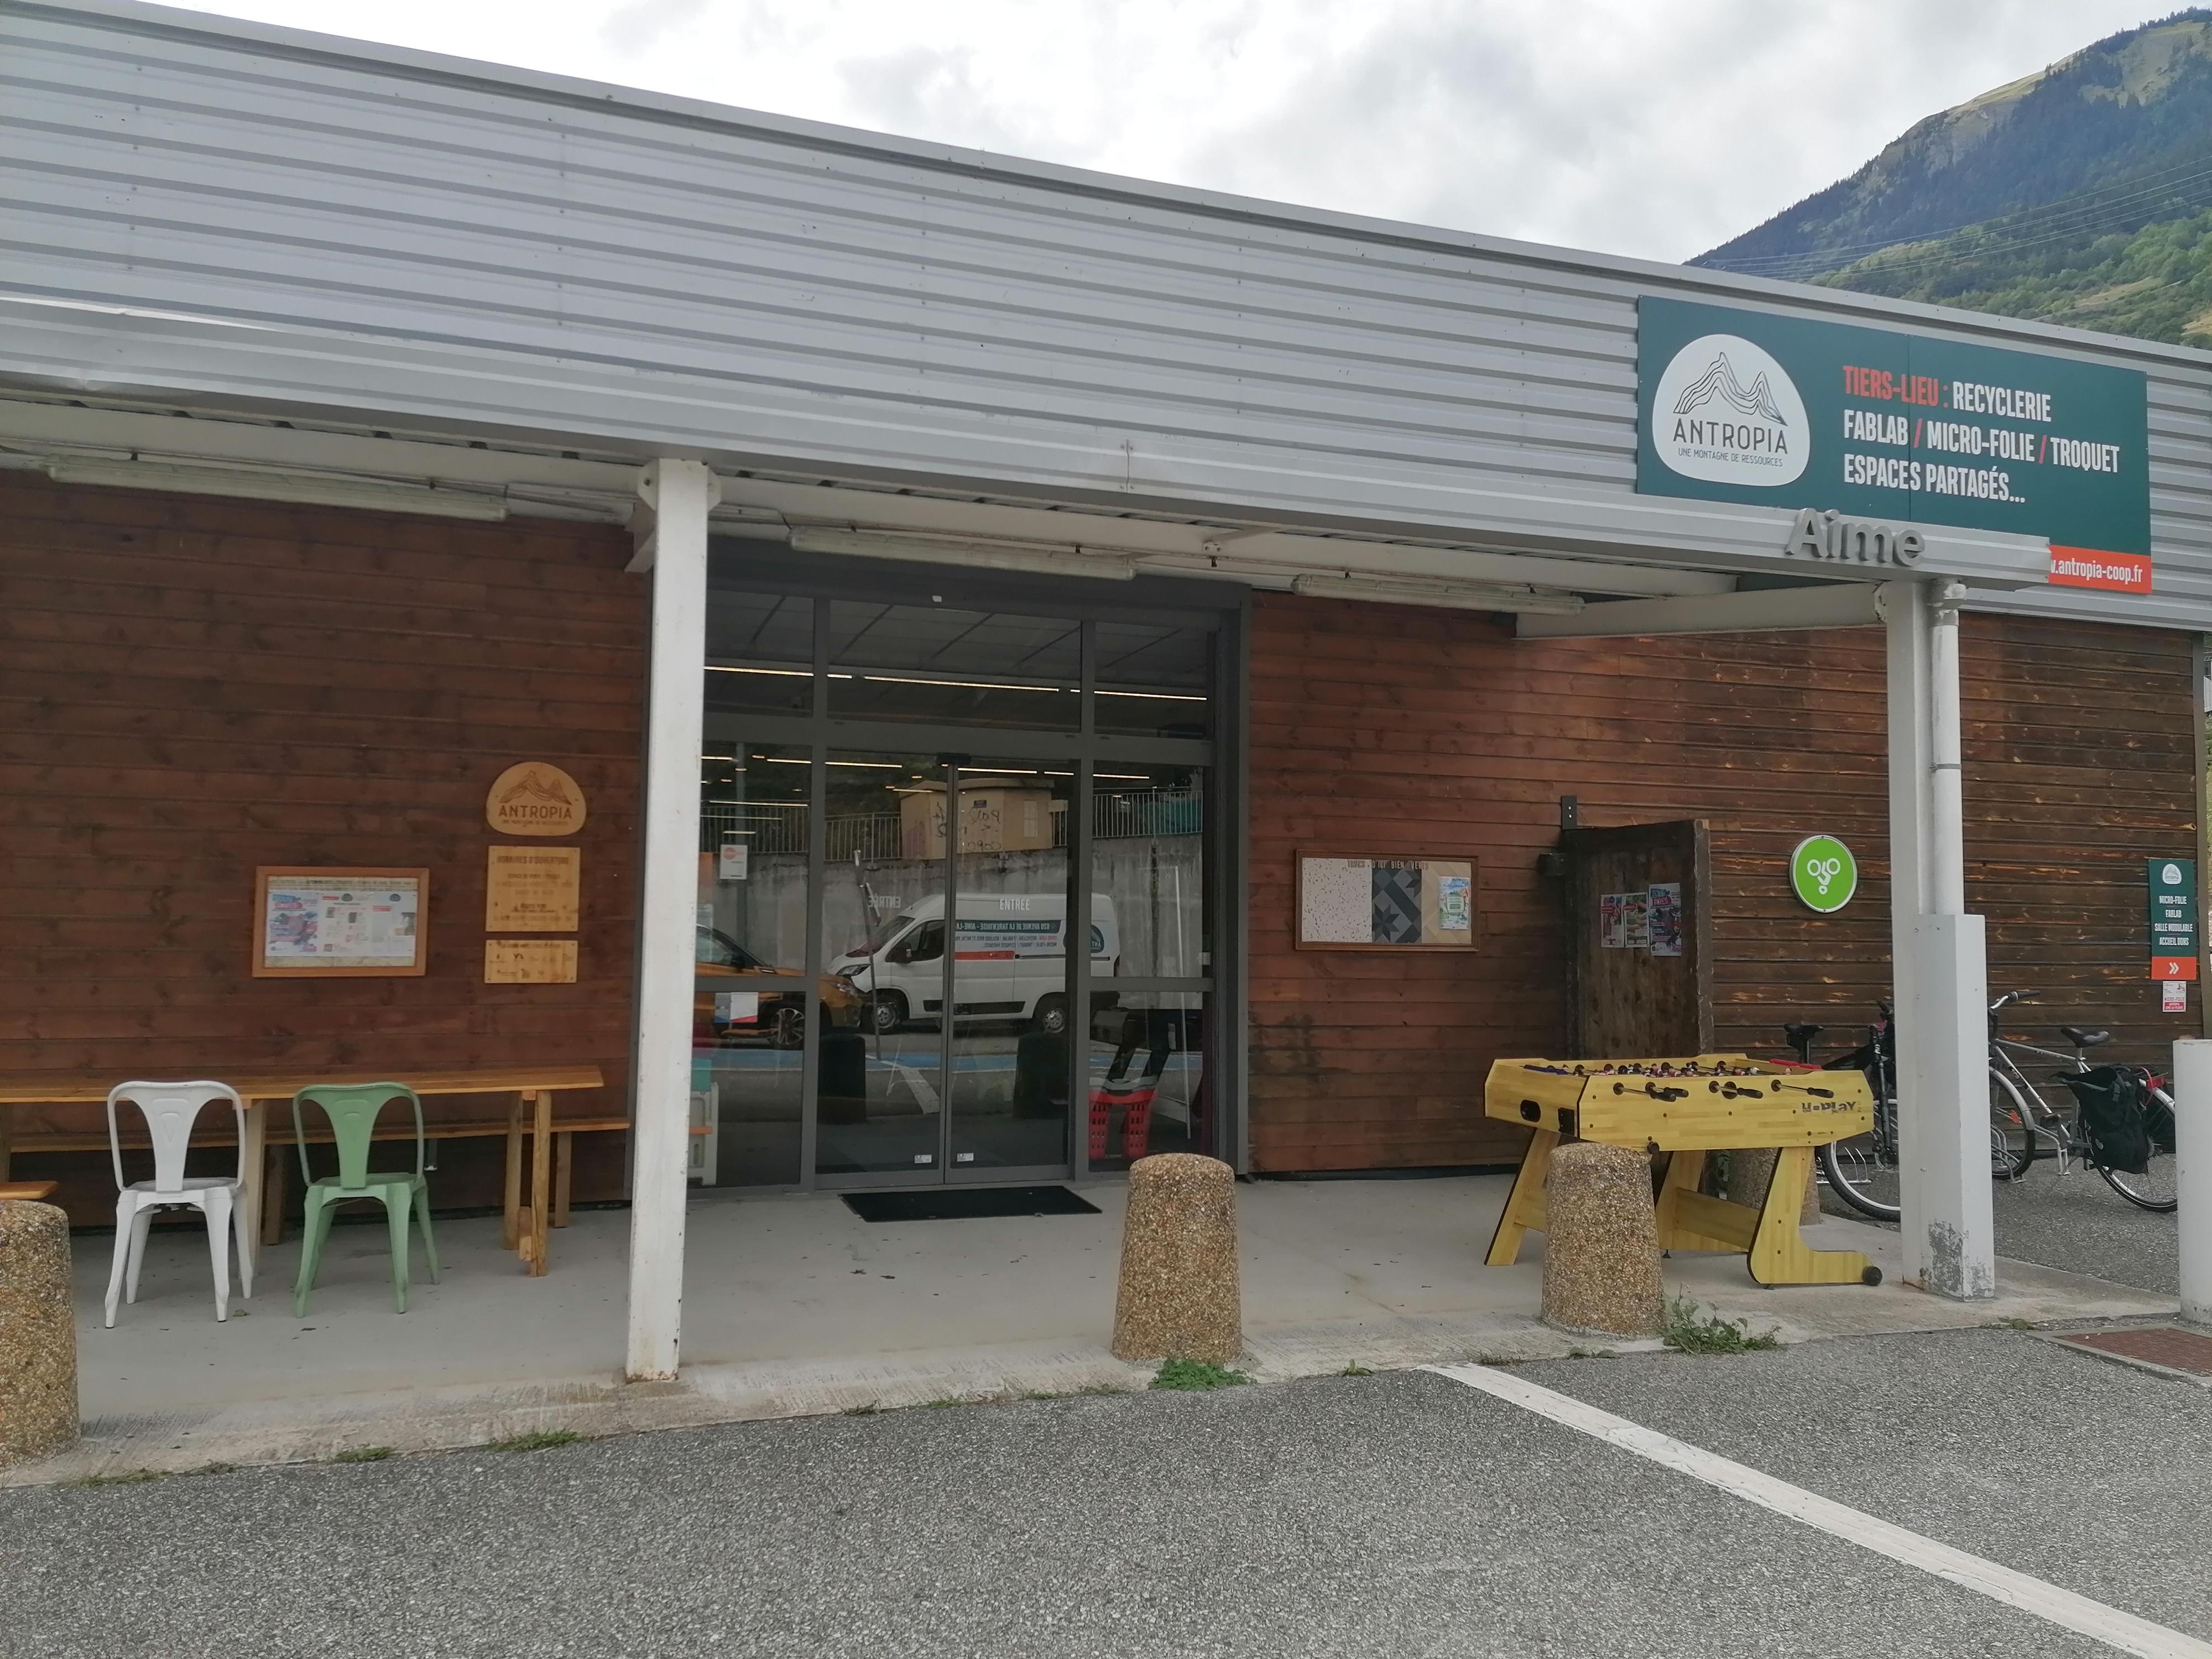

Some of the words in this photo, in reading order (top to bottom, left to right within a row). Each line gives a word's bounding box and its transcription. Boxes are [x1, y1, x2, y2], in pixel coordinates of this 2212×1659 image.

[1843, 366, 1939, 406] TIERS-LIEU
[1953, 382, 2051, 422] RECYCLERIE
[1673, 418, 1788, 454] ANTROPIA
[1844, 410, 1908, 446] FABLAB
[1927, 421, 2035, 462] MICRO-FOLIE
[2050, 437, 2120, 473] TROQUET
[1678, 447, 1691, 457] UNE
[1693, 449, 1729, 461] MONTAGNE
[1731, 453, 1739, 462] DE
[1741, 454, 1783, 467] RESSOURCES
[1844, 453, 1921, 491] ESPACES
[1926, 464, 2026, 503] PARTAGÉS...
[1785, 508, 1925, 567] Aime
[499, 805, 572, 820] ANTROPIA
[2159, 895, 2187, 905] MICRO-FOLIE
[2166, 910, 2182, 918] FABLAB
[2154, 923, 2168, 932] SALLE
[2168, 924, 2193, 932] MODULABLE
[2159, 937, 2177, 946] ACCUEIL
